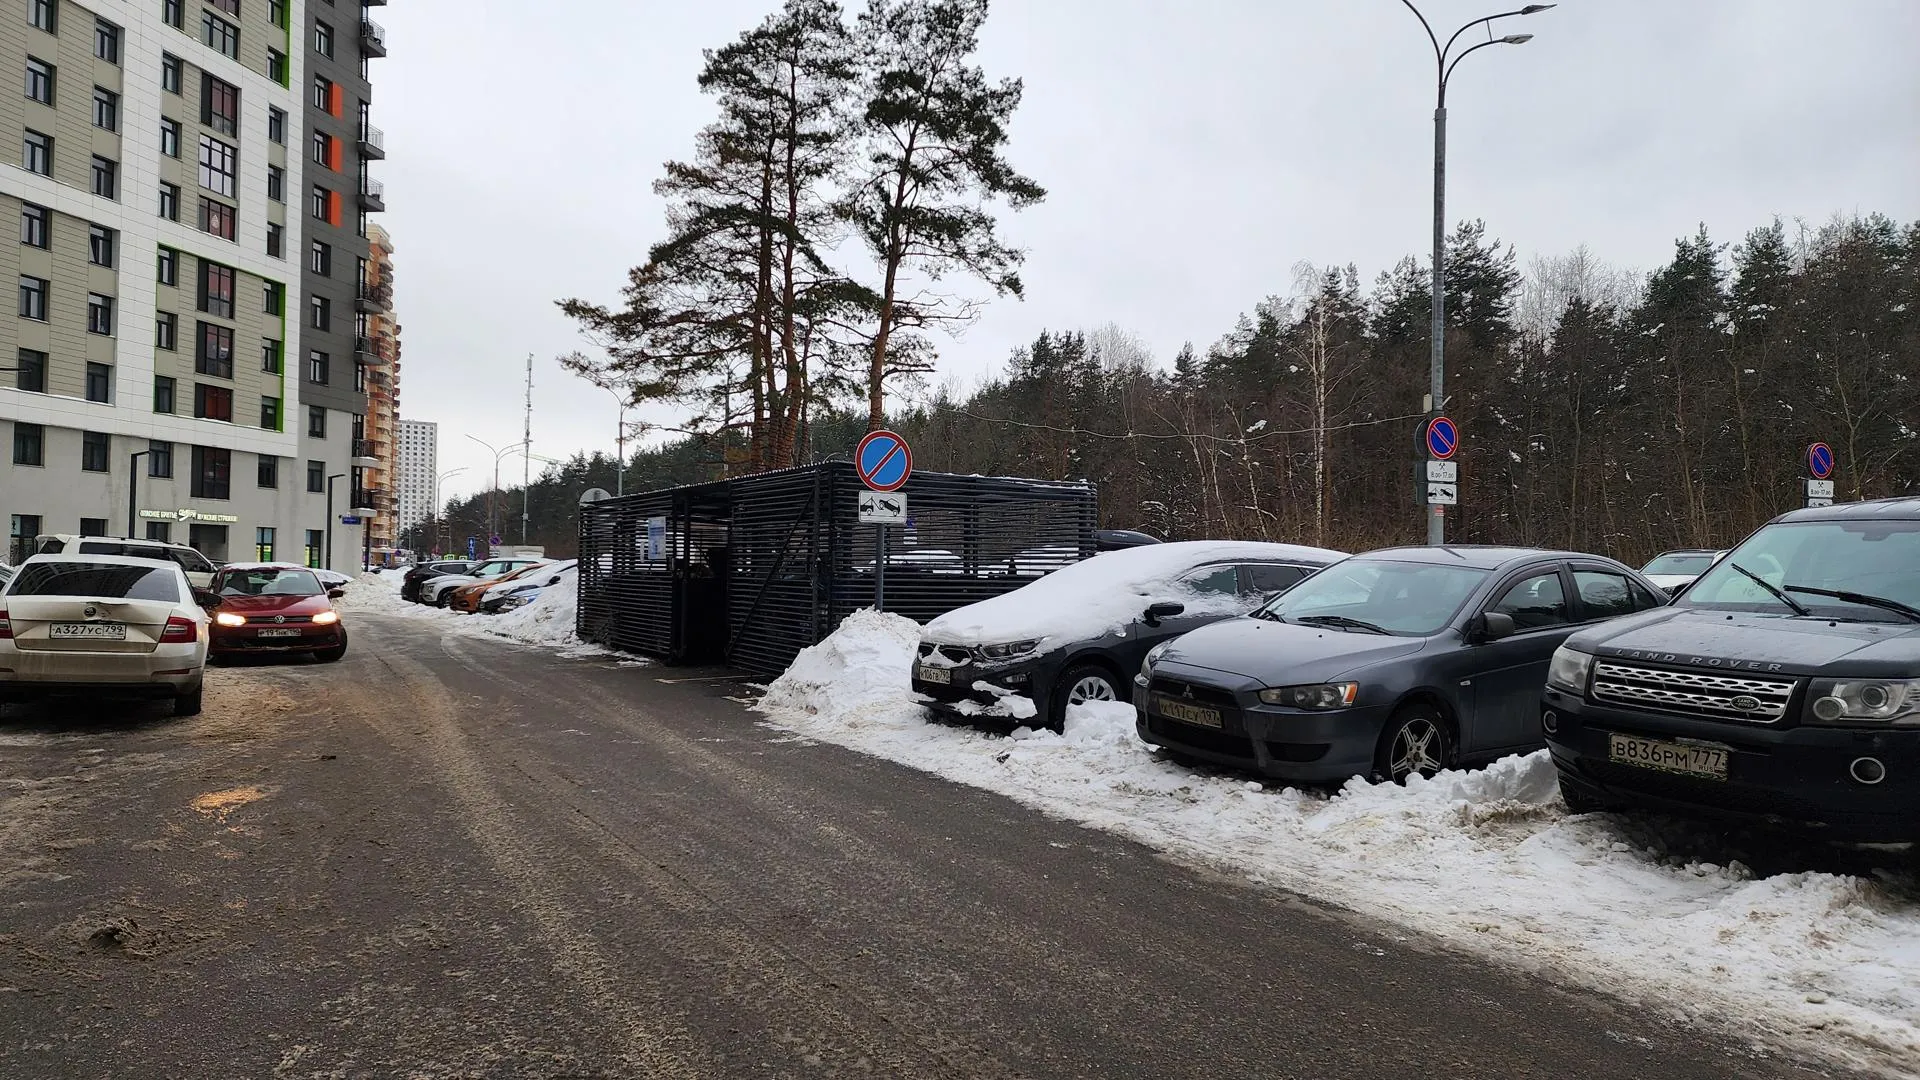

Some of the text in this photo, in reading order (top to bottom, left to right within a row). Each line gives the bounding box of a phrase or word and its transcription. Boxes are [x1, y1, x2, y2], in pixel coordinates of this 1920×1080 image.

[1616, 649, 1782, 672] LAND ROVER
[1691, 749, 1721, 766] 777
